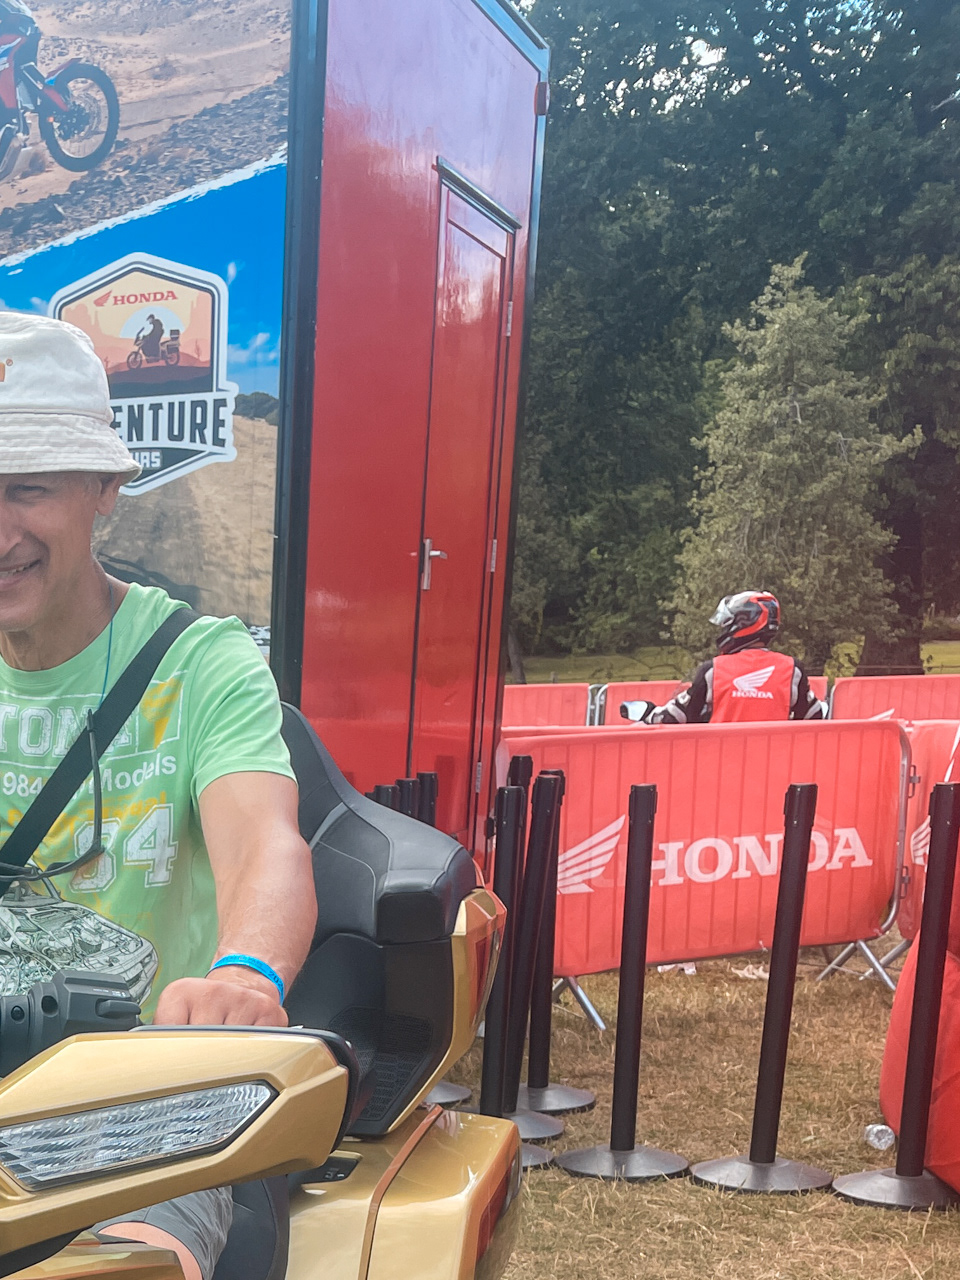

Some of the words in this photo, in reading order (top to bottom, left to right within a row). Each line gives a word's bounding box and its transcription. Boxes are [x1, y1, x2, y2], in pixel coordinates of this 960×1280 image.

[112, 290, 179, 306] HONDA
[731, 690, 774, 700] HONDA
[88, 752, 177, 794] Models
[66, 803, 179, 894] 84
